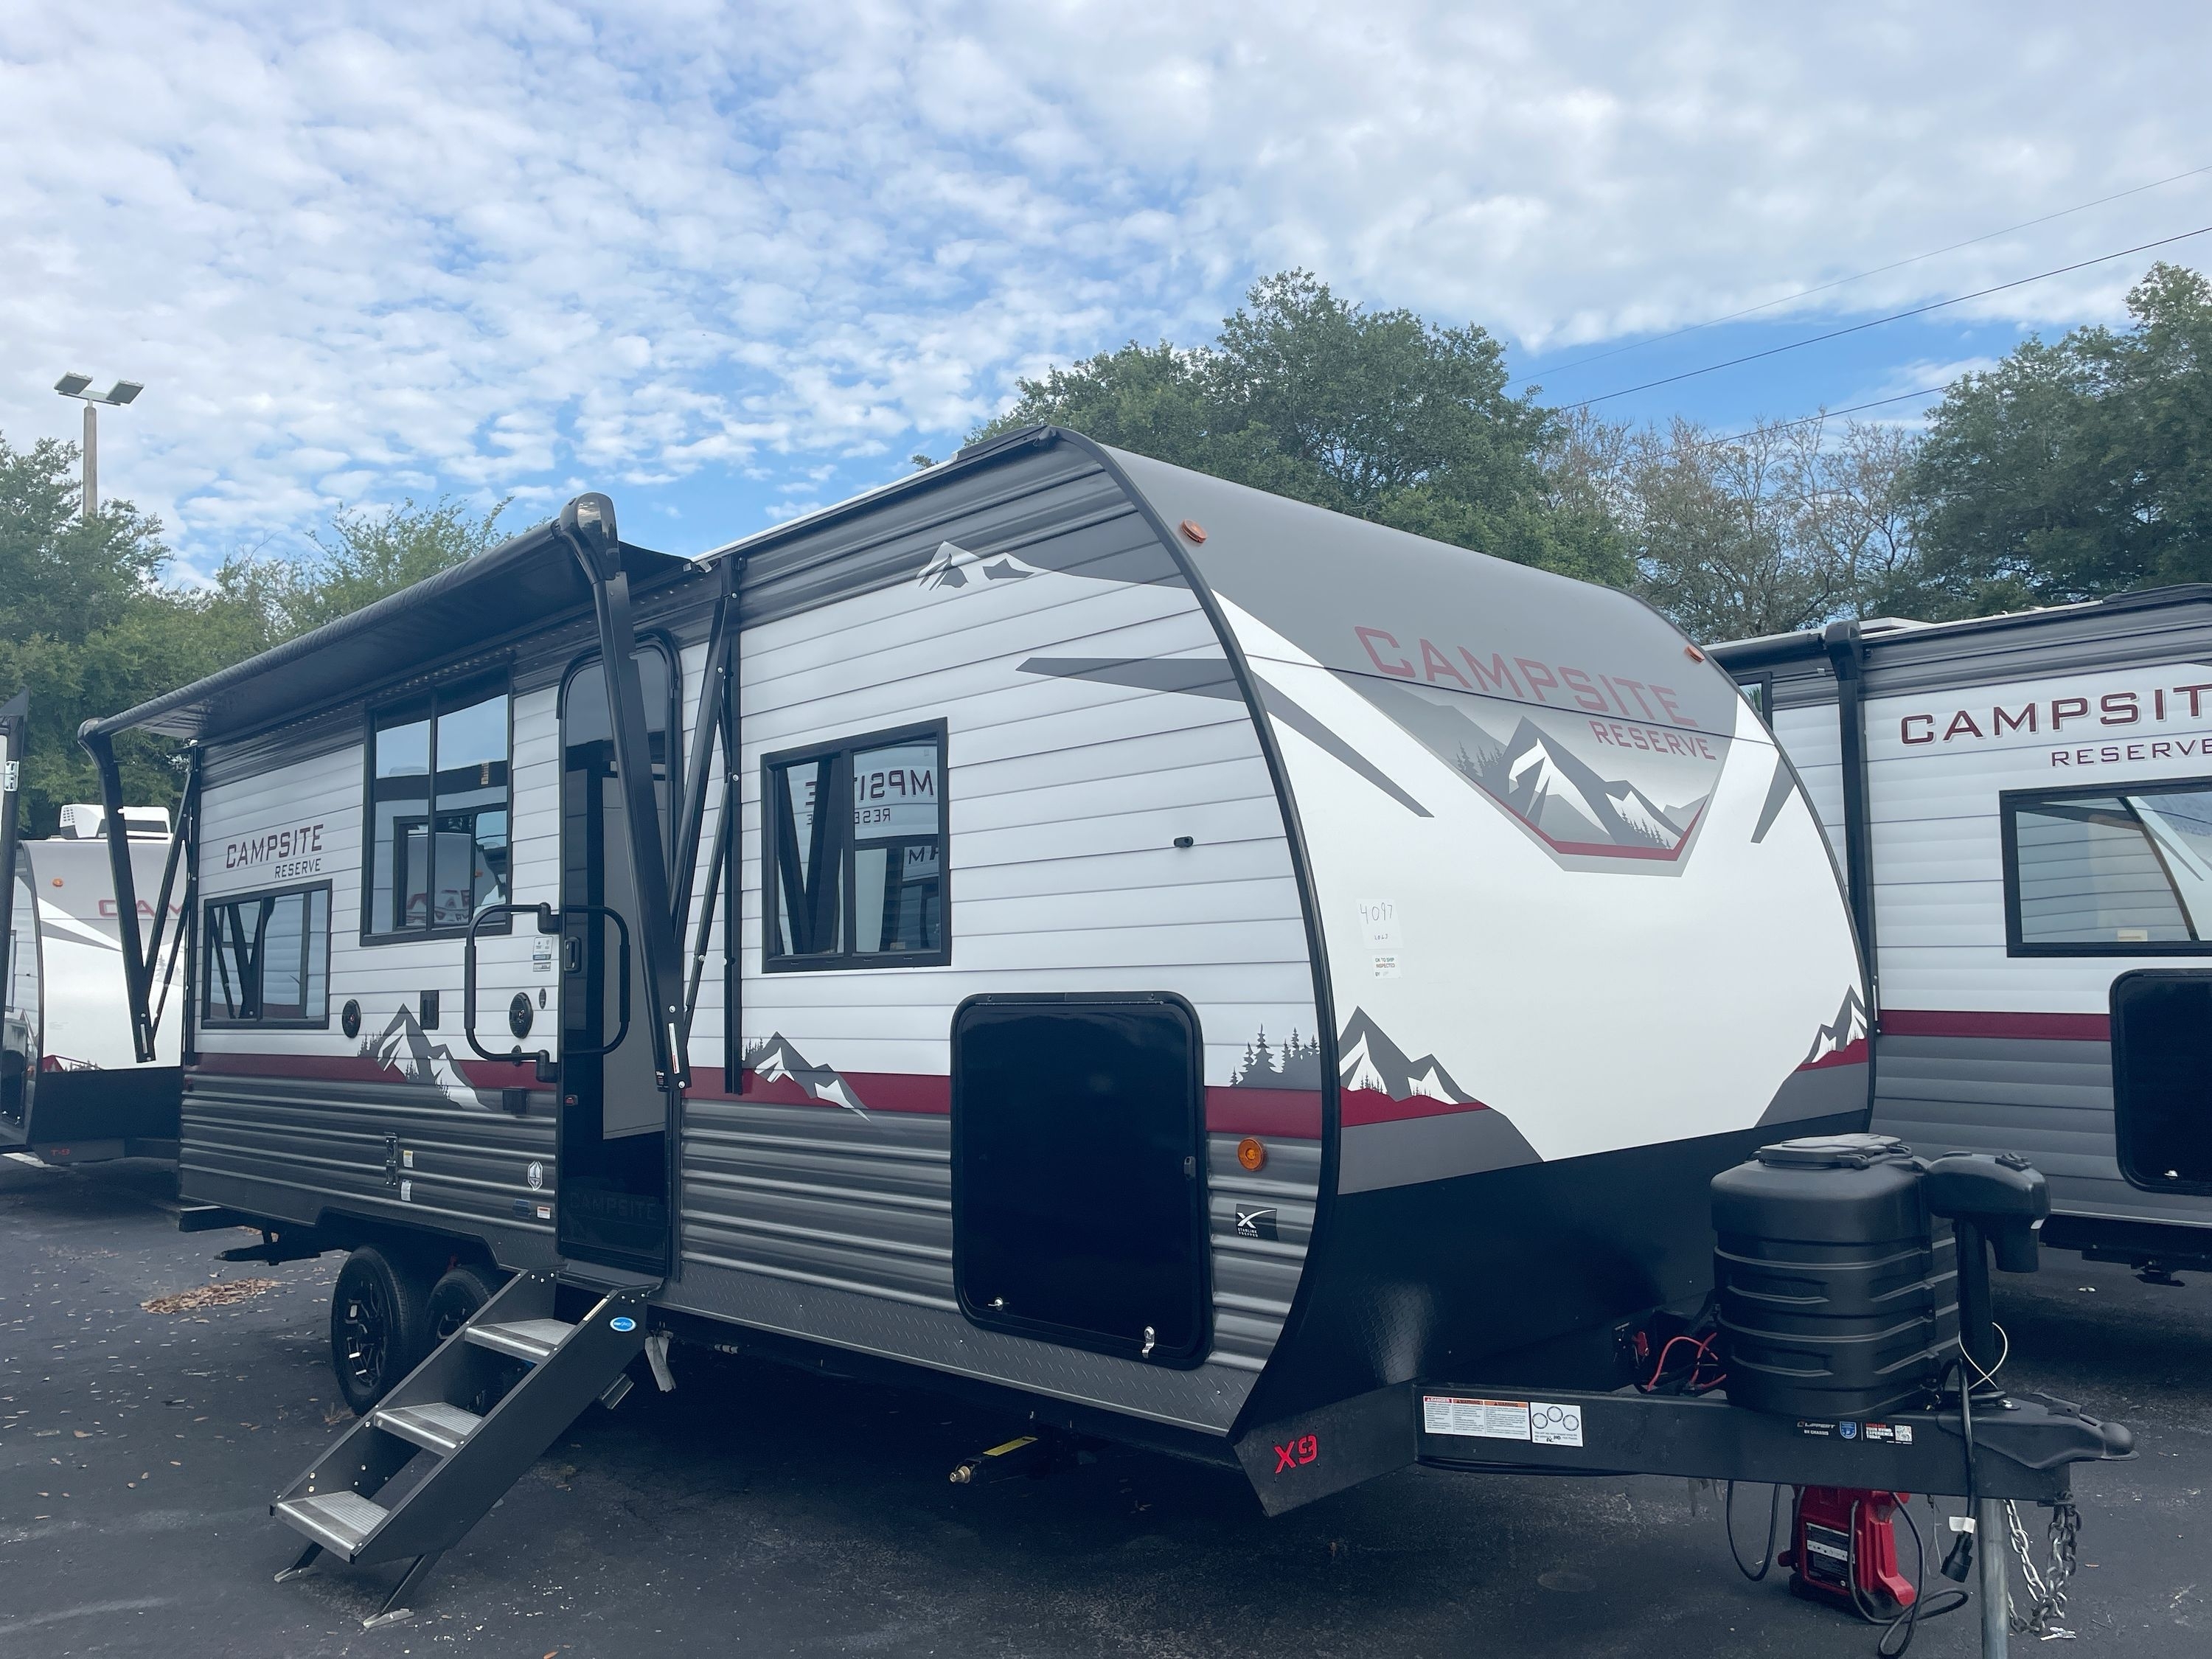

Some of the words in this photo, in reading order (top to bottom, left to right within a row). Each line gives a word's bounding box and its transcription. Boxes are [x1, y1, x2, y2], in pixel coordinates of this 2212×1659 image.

[1354, 626, 1698, 728] CAMPSITE
[1589, 720, 1717, 760] RESERVE
[2051, 738, 2212, 768] RESERVE
[226, 824, 323, 869] CAMPSITE
[275, 858, 321, 879] RESERVE
[1360, 902, 1393, 925] 4097
[1273, 1434, 1318, 1474] X9
